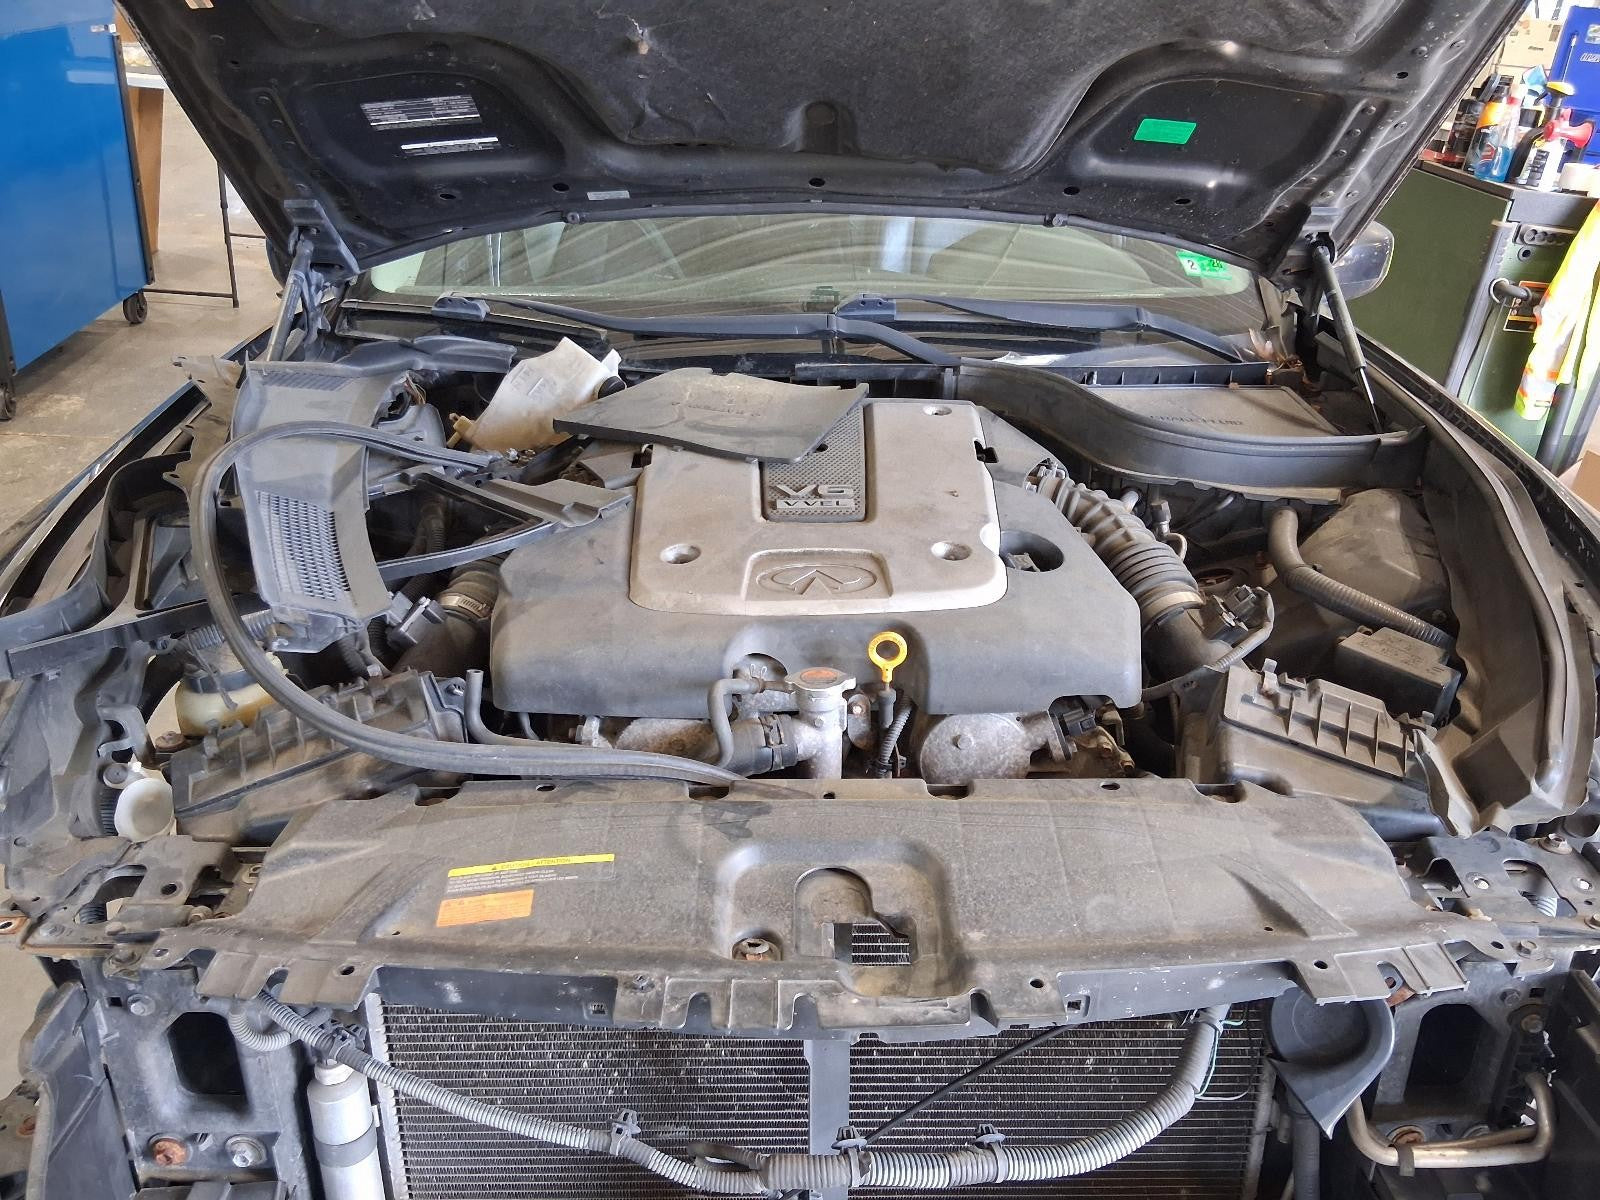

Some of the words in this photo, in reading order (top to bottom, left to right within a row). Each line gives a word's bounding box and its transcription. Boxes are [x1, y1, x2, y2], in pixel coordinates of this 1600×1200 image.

[1187, 259, 1197, 270] 2
[776, 484, 854, 499] V6
[781, 499, 850, 508] VVEL
[535, 857, 571, 866] ATTENTION
